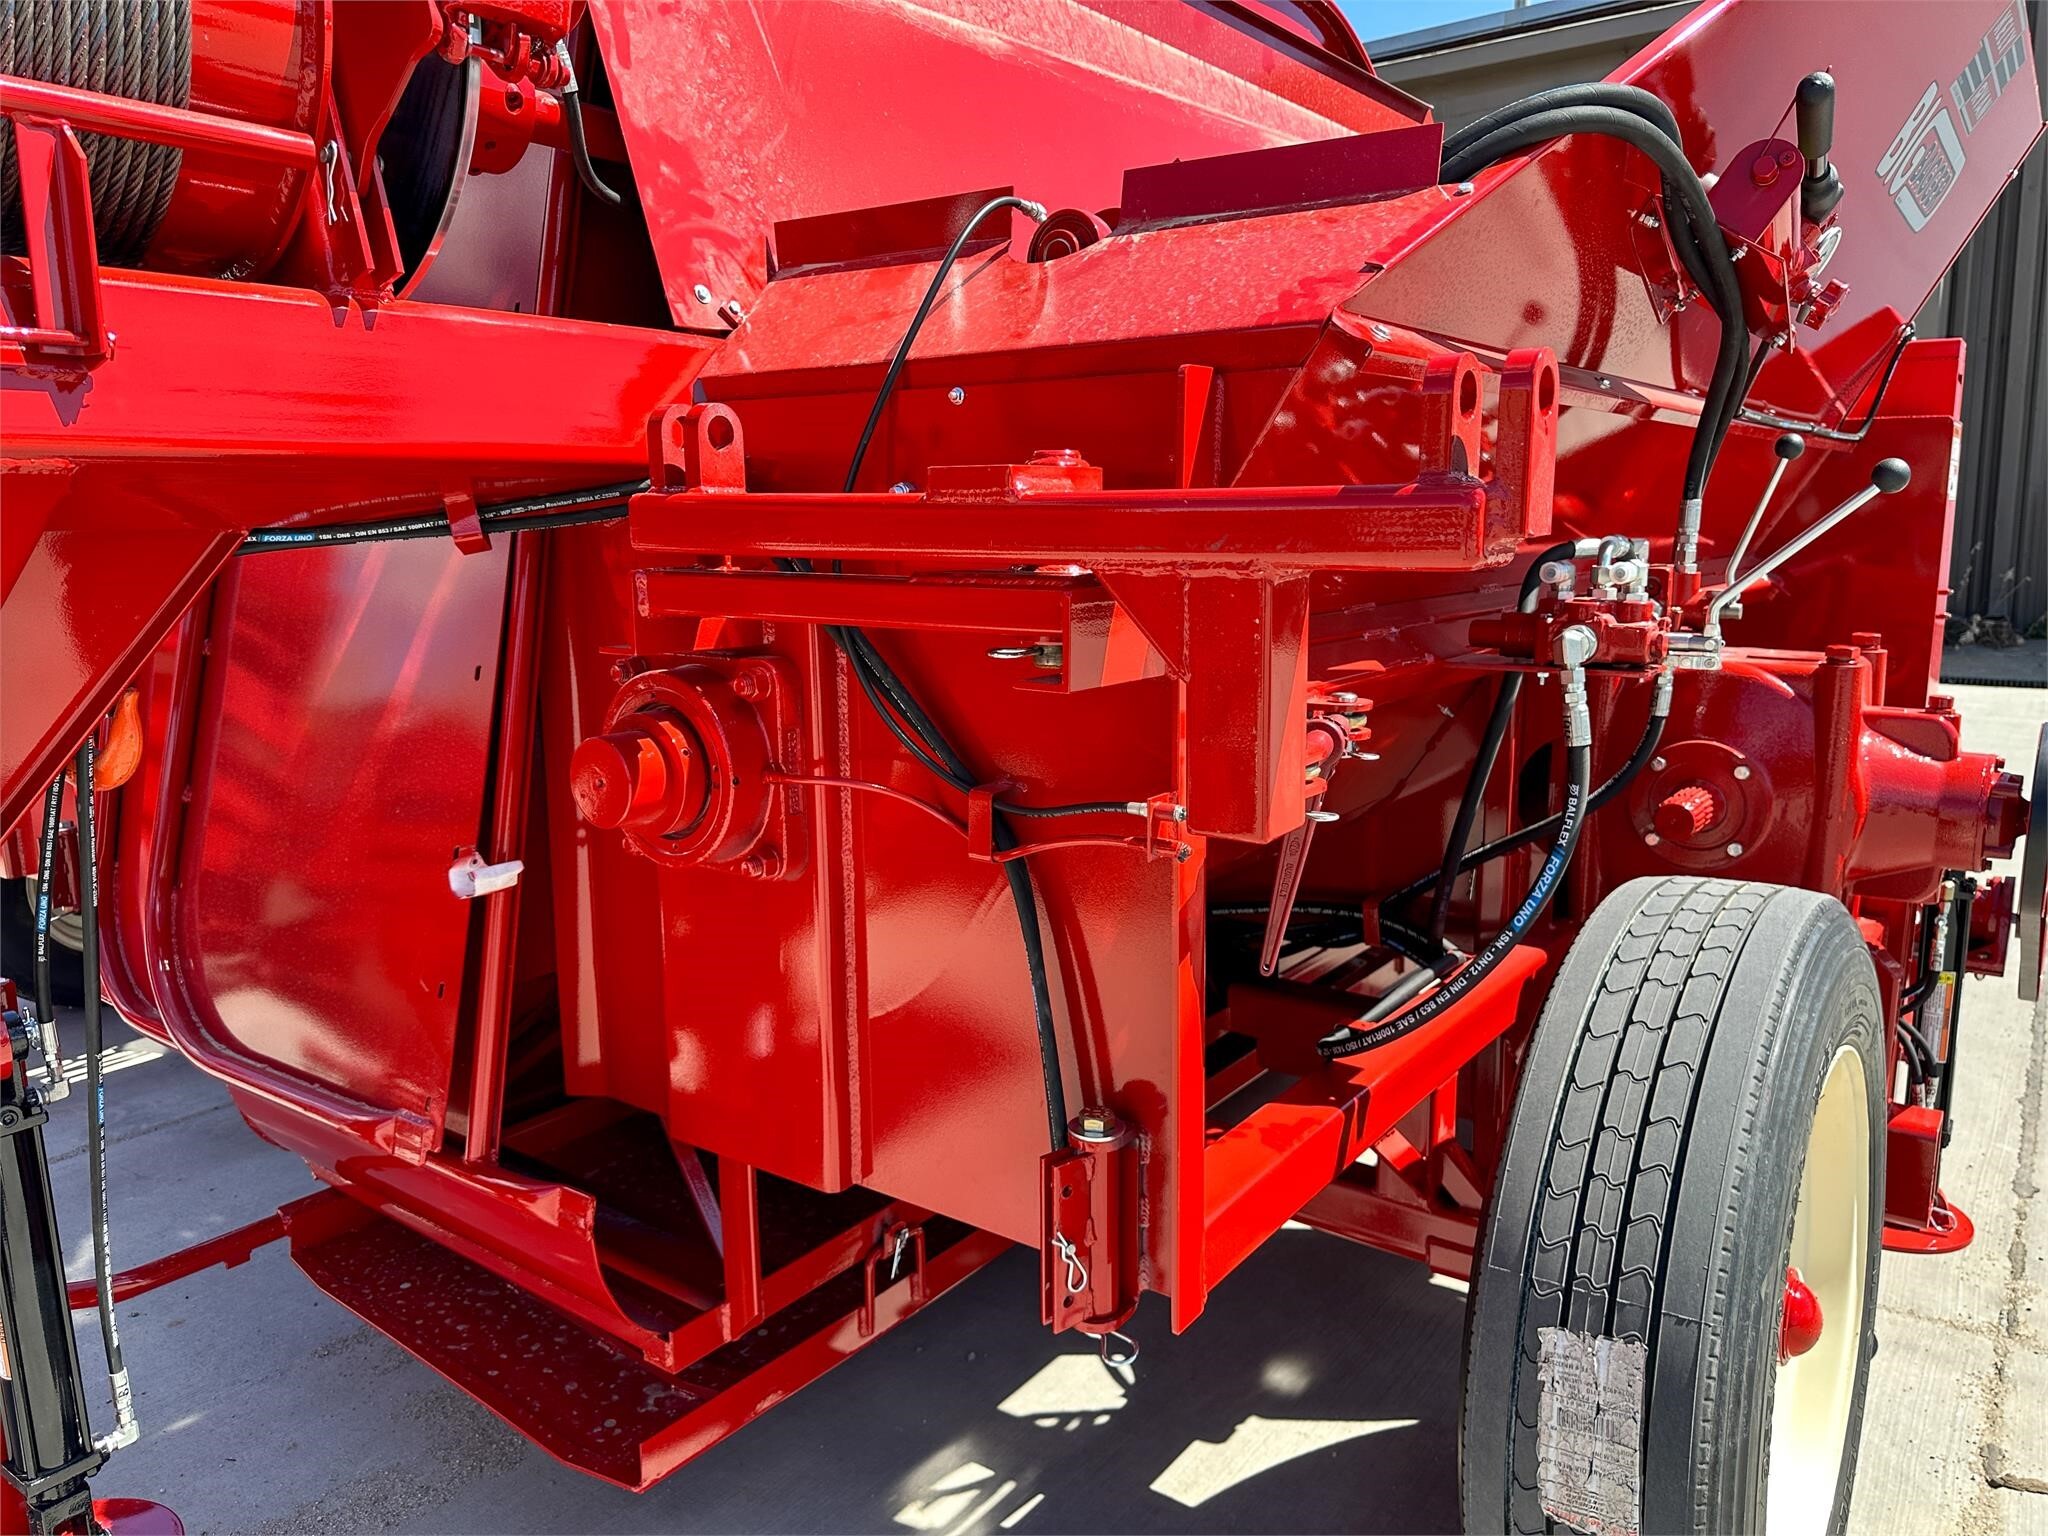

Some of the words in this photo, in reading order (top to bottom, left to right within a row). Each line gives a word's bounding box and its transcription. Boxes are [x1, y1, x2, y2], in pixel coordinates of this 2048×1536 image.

[1993, 9, 2017, 54] KELLY
[1970, 81, 1993, 120] RYAN
[294, 534, 313, 542] UNO
[1557, 797, 1578, 848] BALFLEX
[1531, 855, 1560, 898] FORZA
[40, 895, 48, 909] UNO
[38, 909, 47, 930] FORZA
[1513, 899, 1536, 927] UNO
[37, 933, 45, 955] BALFLEX
[1496, 930, 1513, 951] 1SN
[1468, 952, 1494, 976] DN12
[1450, 976, 1468, 995] DIN
[1419, 1000, 1437, 1016] 853
[1435, 990, 1451, 1005] EN
[1396, 1012, 1415, 1031] SAE
[1362, 1025, 1396, 1046] 100R1AT
